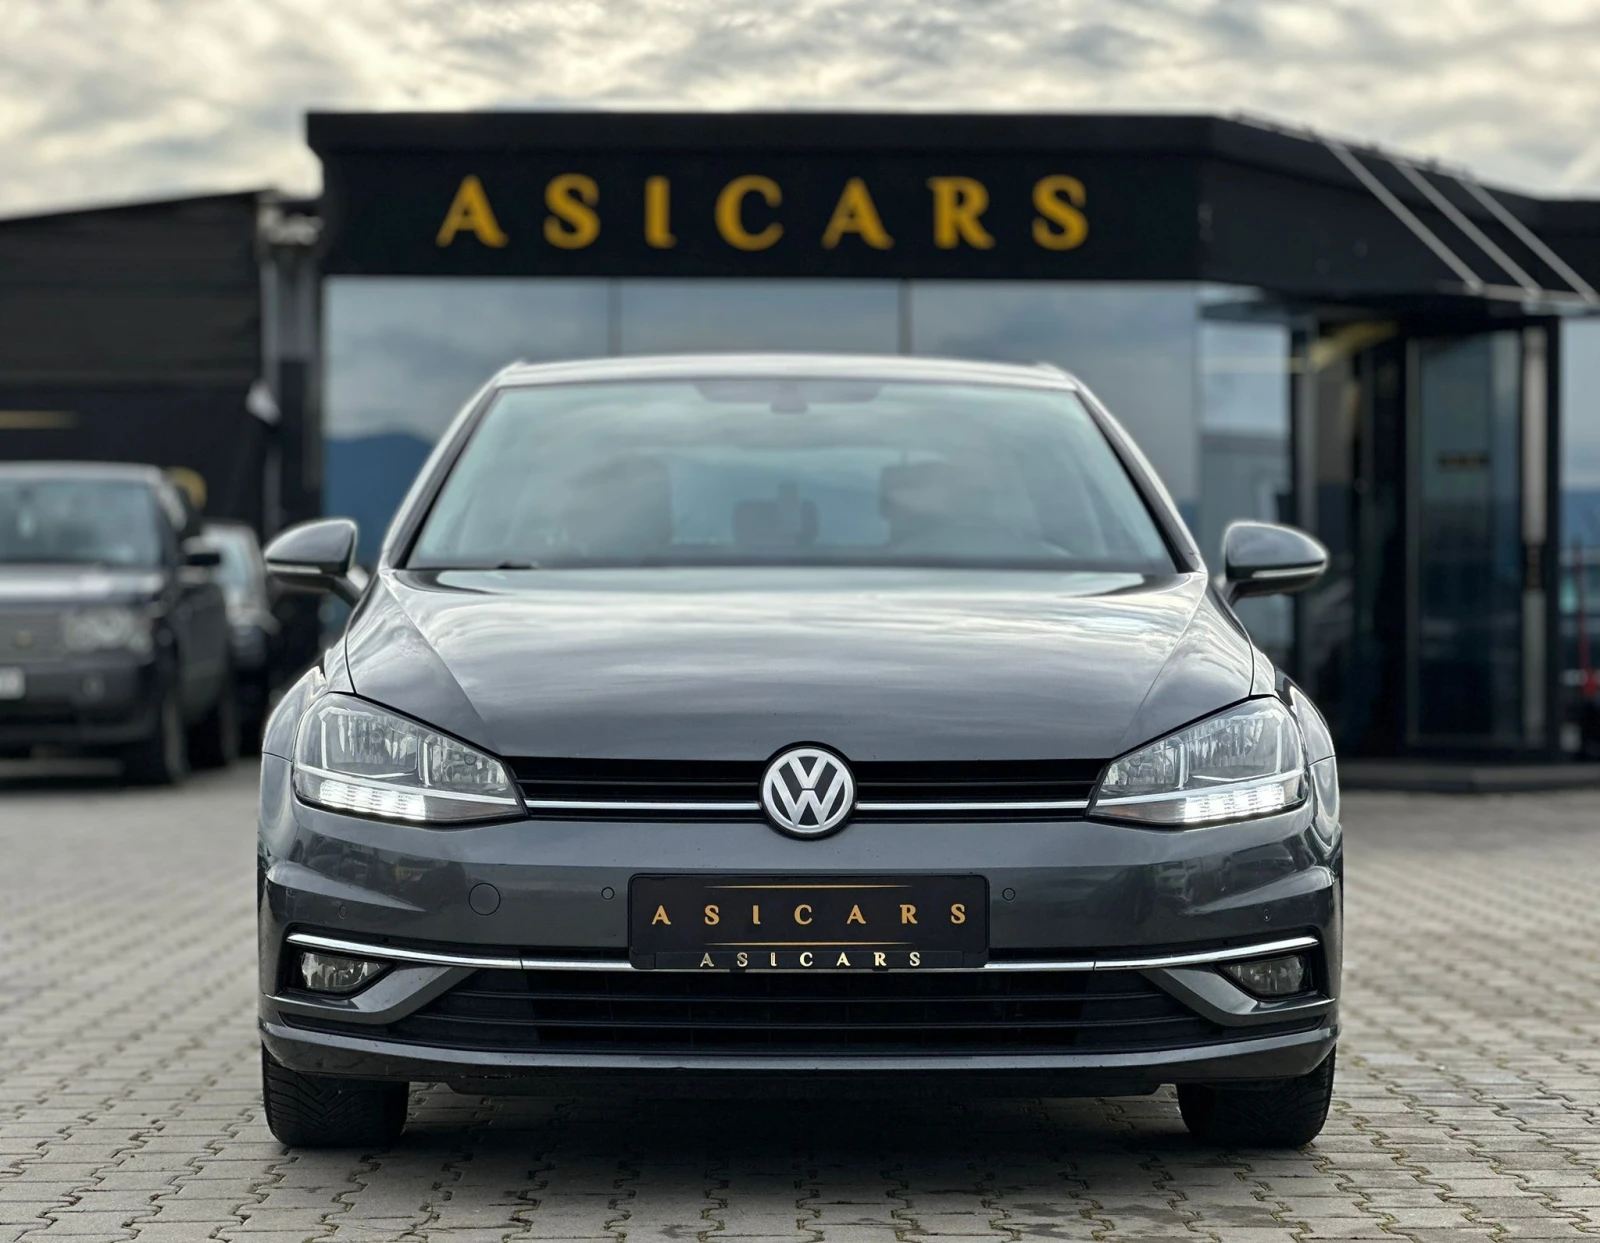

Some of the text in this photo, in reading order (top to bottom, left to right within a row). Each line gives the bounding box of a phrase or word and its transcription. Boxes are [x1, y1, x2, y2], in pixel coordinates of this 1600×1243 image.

[436, 173, 1090, 251] ASICARS
[766, 752, 850, 830] VW
[652, 903, 966, 925] ASICARS
[700, 952, 921, 967] ASICARS
